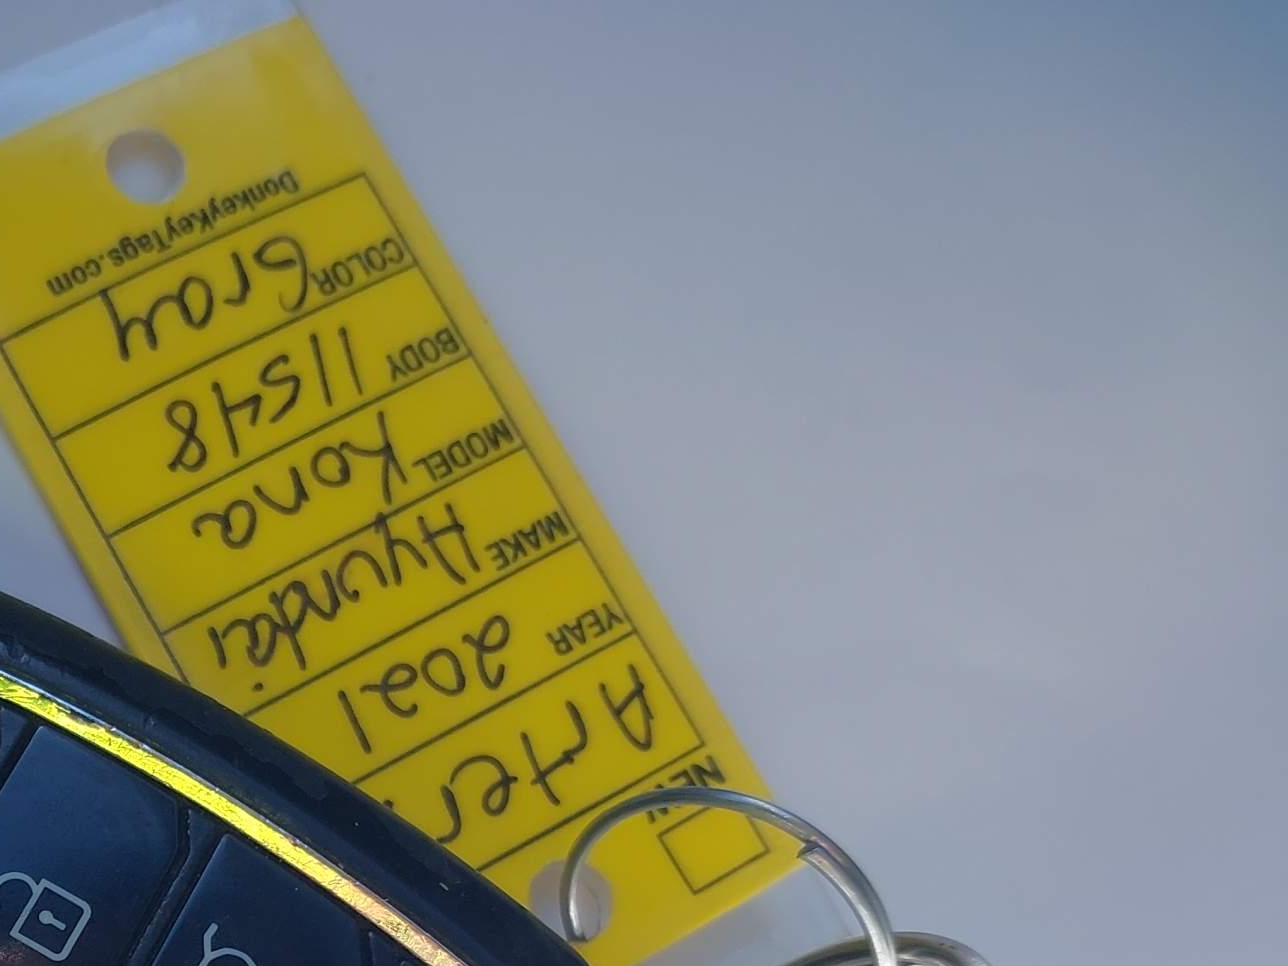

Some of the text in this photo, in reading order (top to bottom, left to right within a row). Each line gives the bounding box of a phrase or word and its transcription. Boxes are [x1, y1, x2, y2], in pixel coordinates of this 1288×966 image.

[46, 170, 299, 295] DonkeyKeyTags.com
[309, 236, 405, 297] COLOR
[98, 235, 310, 361] Gray
[386, 327, 460, 382] BODY
[165, 326, 364, 472] 11548
[412, 418, 513, 482] MODEL
[192, 410, 408, 550] Kona
[484, 510, 570, 572] MAKE
[207, 503, 480, 692] Hyundai
[547, 602, 623, 656] YEAR
[337, 614, 511, 754] 2021
